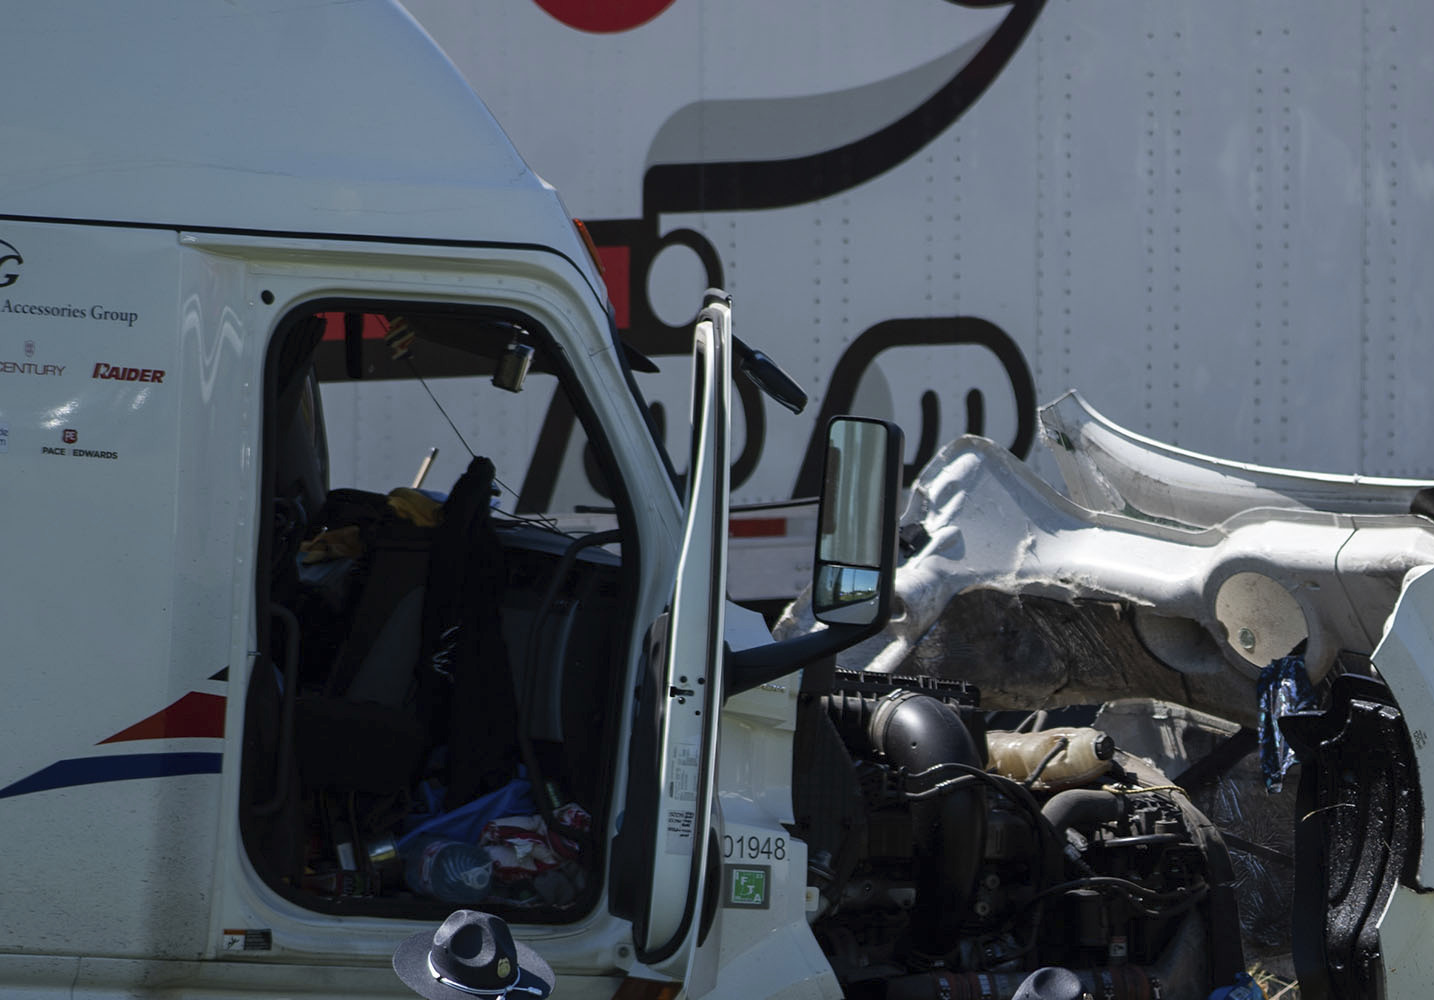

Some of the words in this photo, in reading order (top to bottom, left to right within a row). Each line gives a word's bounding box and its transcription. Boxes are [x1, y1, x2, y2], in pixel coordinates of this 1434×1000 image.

[2, 300, 87, 319] Accessories
[91, 305, 138, 327] Group
[92, 363, 166, 383] RAIDER
[42, 447, 66, 456] PACE
[73, 449, 118, 459] EDWARDS
